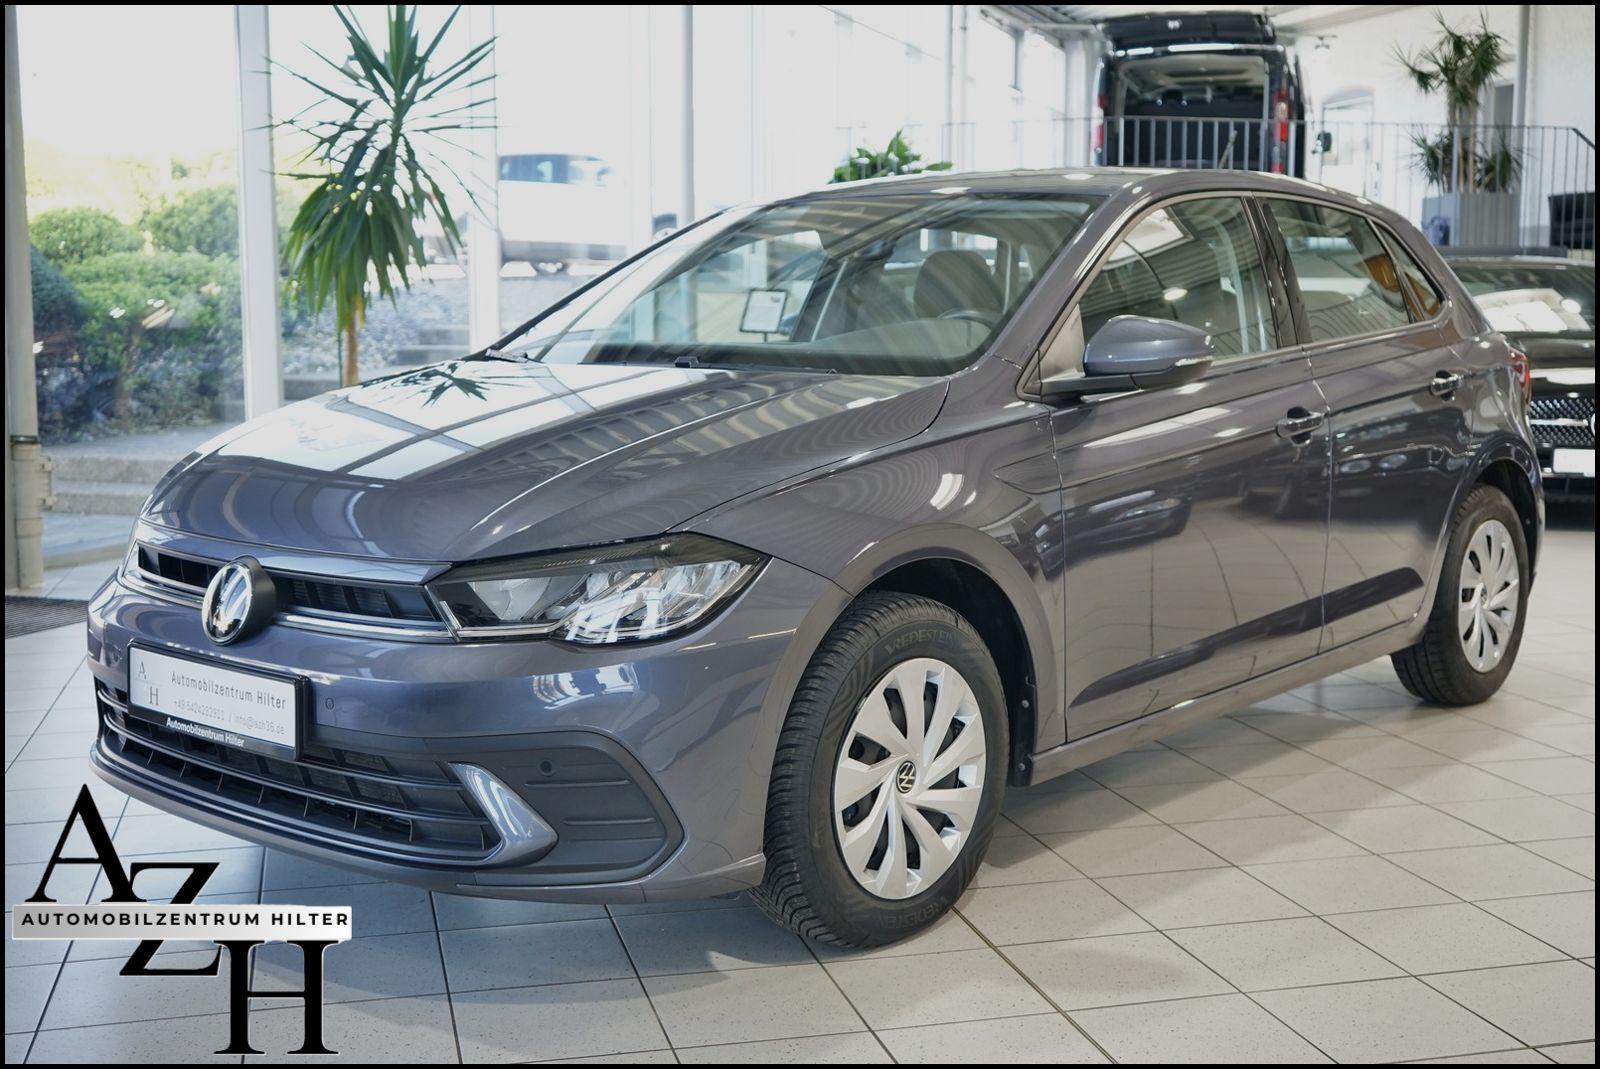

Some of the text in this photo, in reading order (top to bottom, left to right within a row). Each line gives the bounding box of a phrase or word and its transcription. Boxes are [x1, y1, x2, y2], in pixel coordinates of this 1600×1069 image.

[138, 661, 147, 681] A
[149, 687, 160, 706] H
[171, 672, 286, 710] Automobilzentrum Hilter
[166, 717, 245, 748] Automobilzentrum Hilter
